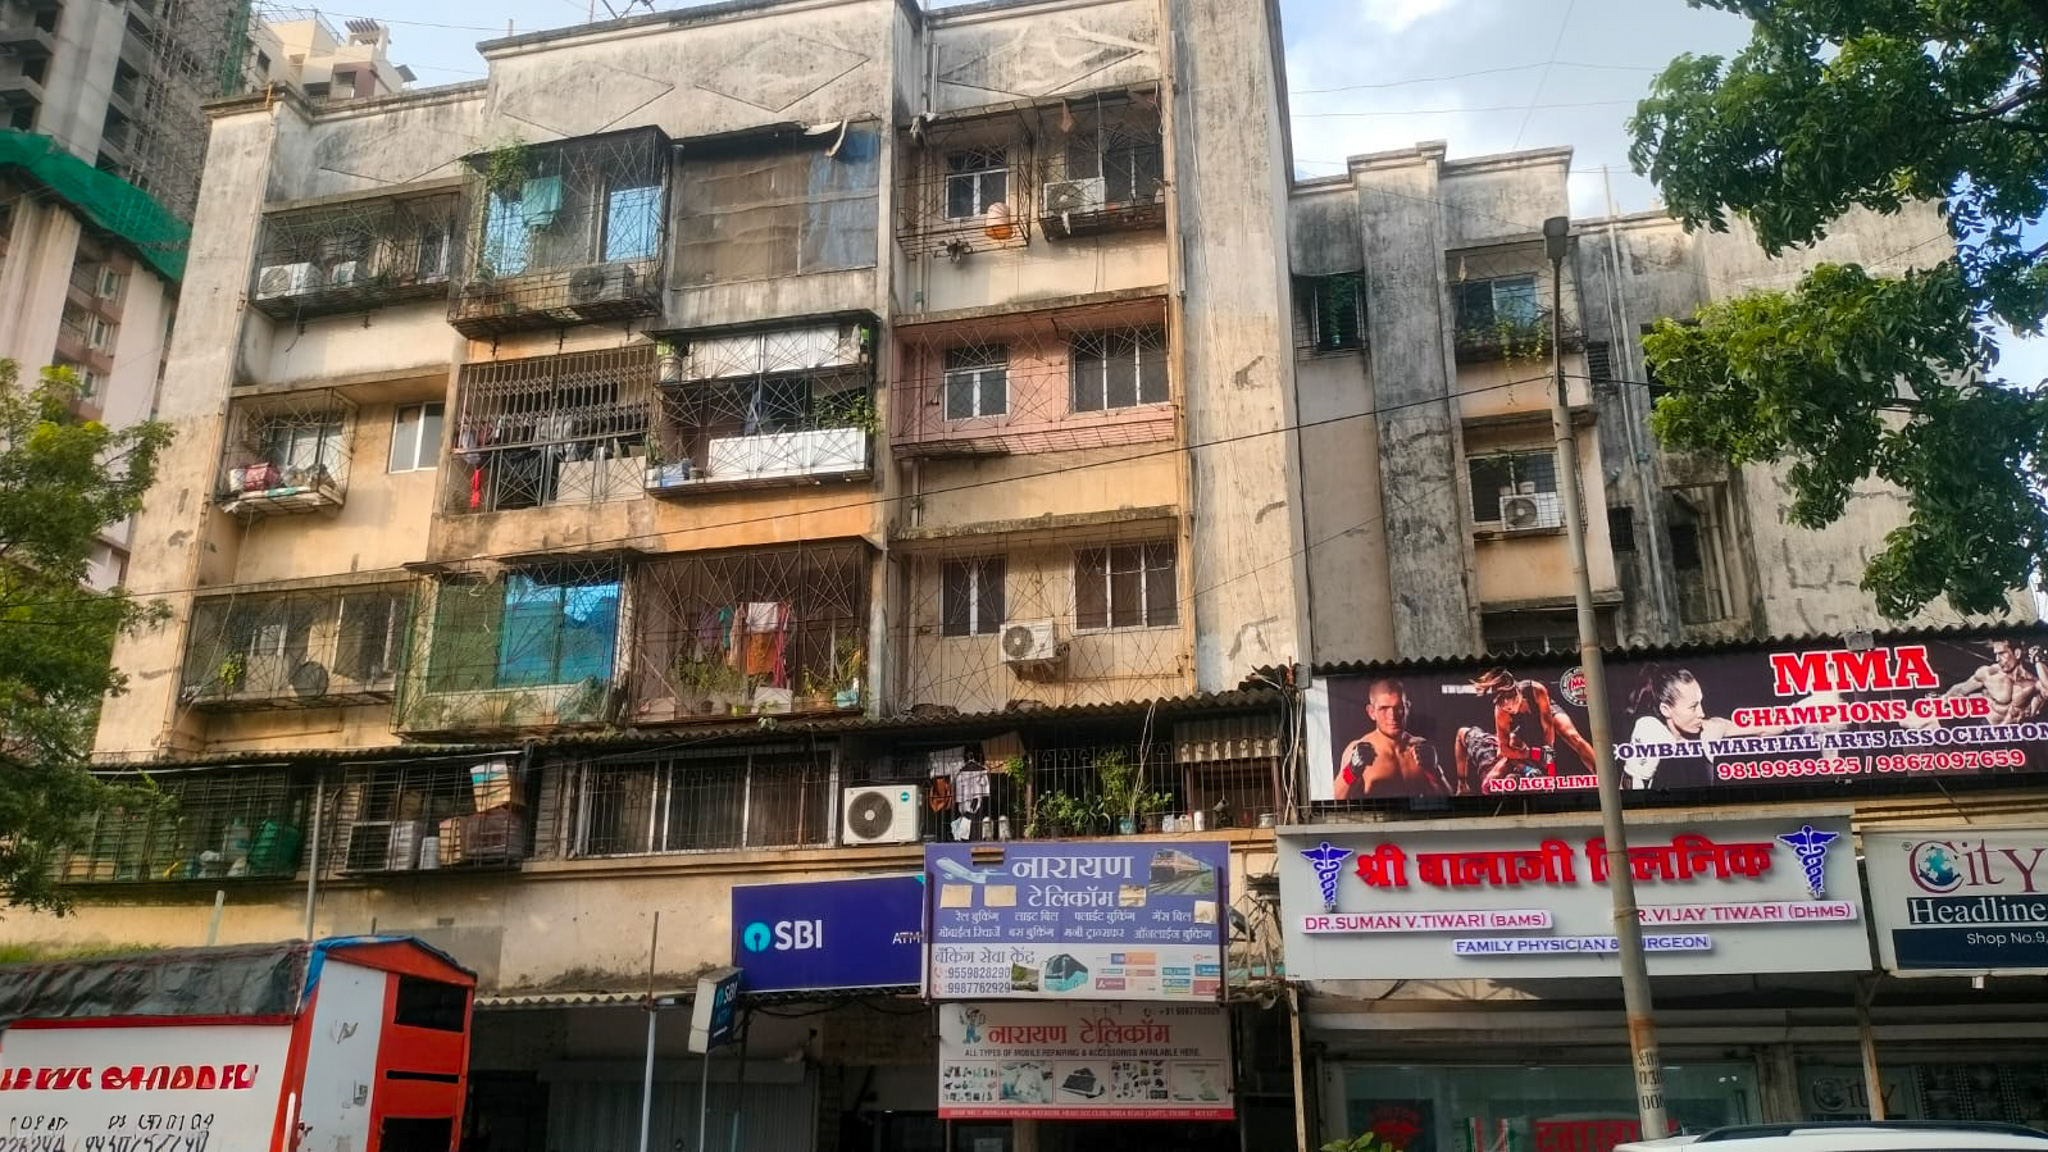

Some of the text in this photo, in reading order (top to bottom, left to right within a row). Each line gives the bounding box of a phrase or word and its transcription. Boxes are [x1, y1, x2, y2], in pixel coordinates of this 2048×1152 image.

[1770, 645, 1940, 696] MMA
[1732, 696, 1991, 729] CHAMPIONS CLUB
[1613, 722, 2048, 762] OMBAT MARTIAL ARTS ASSOCIATION
[1718, 749, 2026, 780] 9819939325 / 9867097659
[1490, 775, 1599, 791] NO AGE LIMI
[1011, 856, 1135, 879] नारायण
[1354, 843, 1408, 887] श्री
[1416, 839, 1577, 886] बालाजी
[1028, 884, 1115, 907] टेलिकॉम
[1305, 912, 1546, 930] DR.SUMAN V.TIWARI (BAMS)
[1639, 903, 1851, 922] R.VIJAY TIWARI (DHMS)
[774, 920, 823, 950] SBI
[892, 932, 920, 945] ATM
[1456, 940, 1513, 952] FAMILY
[1518, 938, 1606, 952] PHYSICIAN
[1642, 936, 1708, 949] RGEON
[1966, 932, 2007, 947] Shop
[979, 946, 1006, 963] सेवा
[988, 1017, 1174, 1044] नारायण टेलिकॉम
[965, 1047, 977, 1057] ALL
[980, 1047, 1001, 1057] TYPES
[1003, 1047, 1012, 1057] OF
[1139, 1047, 1178, 1057] AVAILABLE
